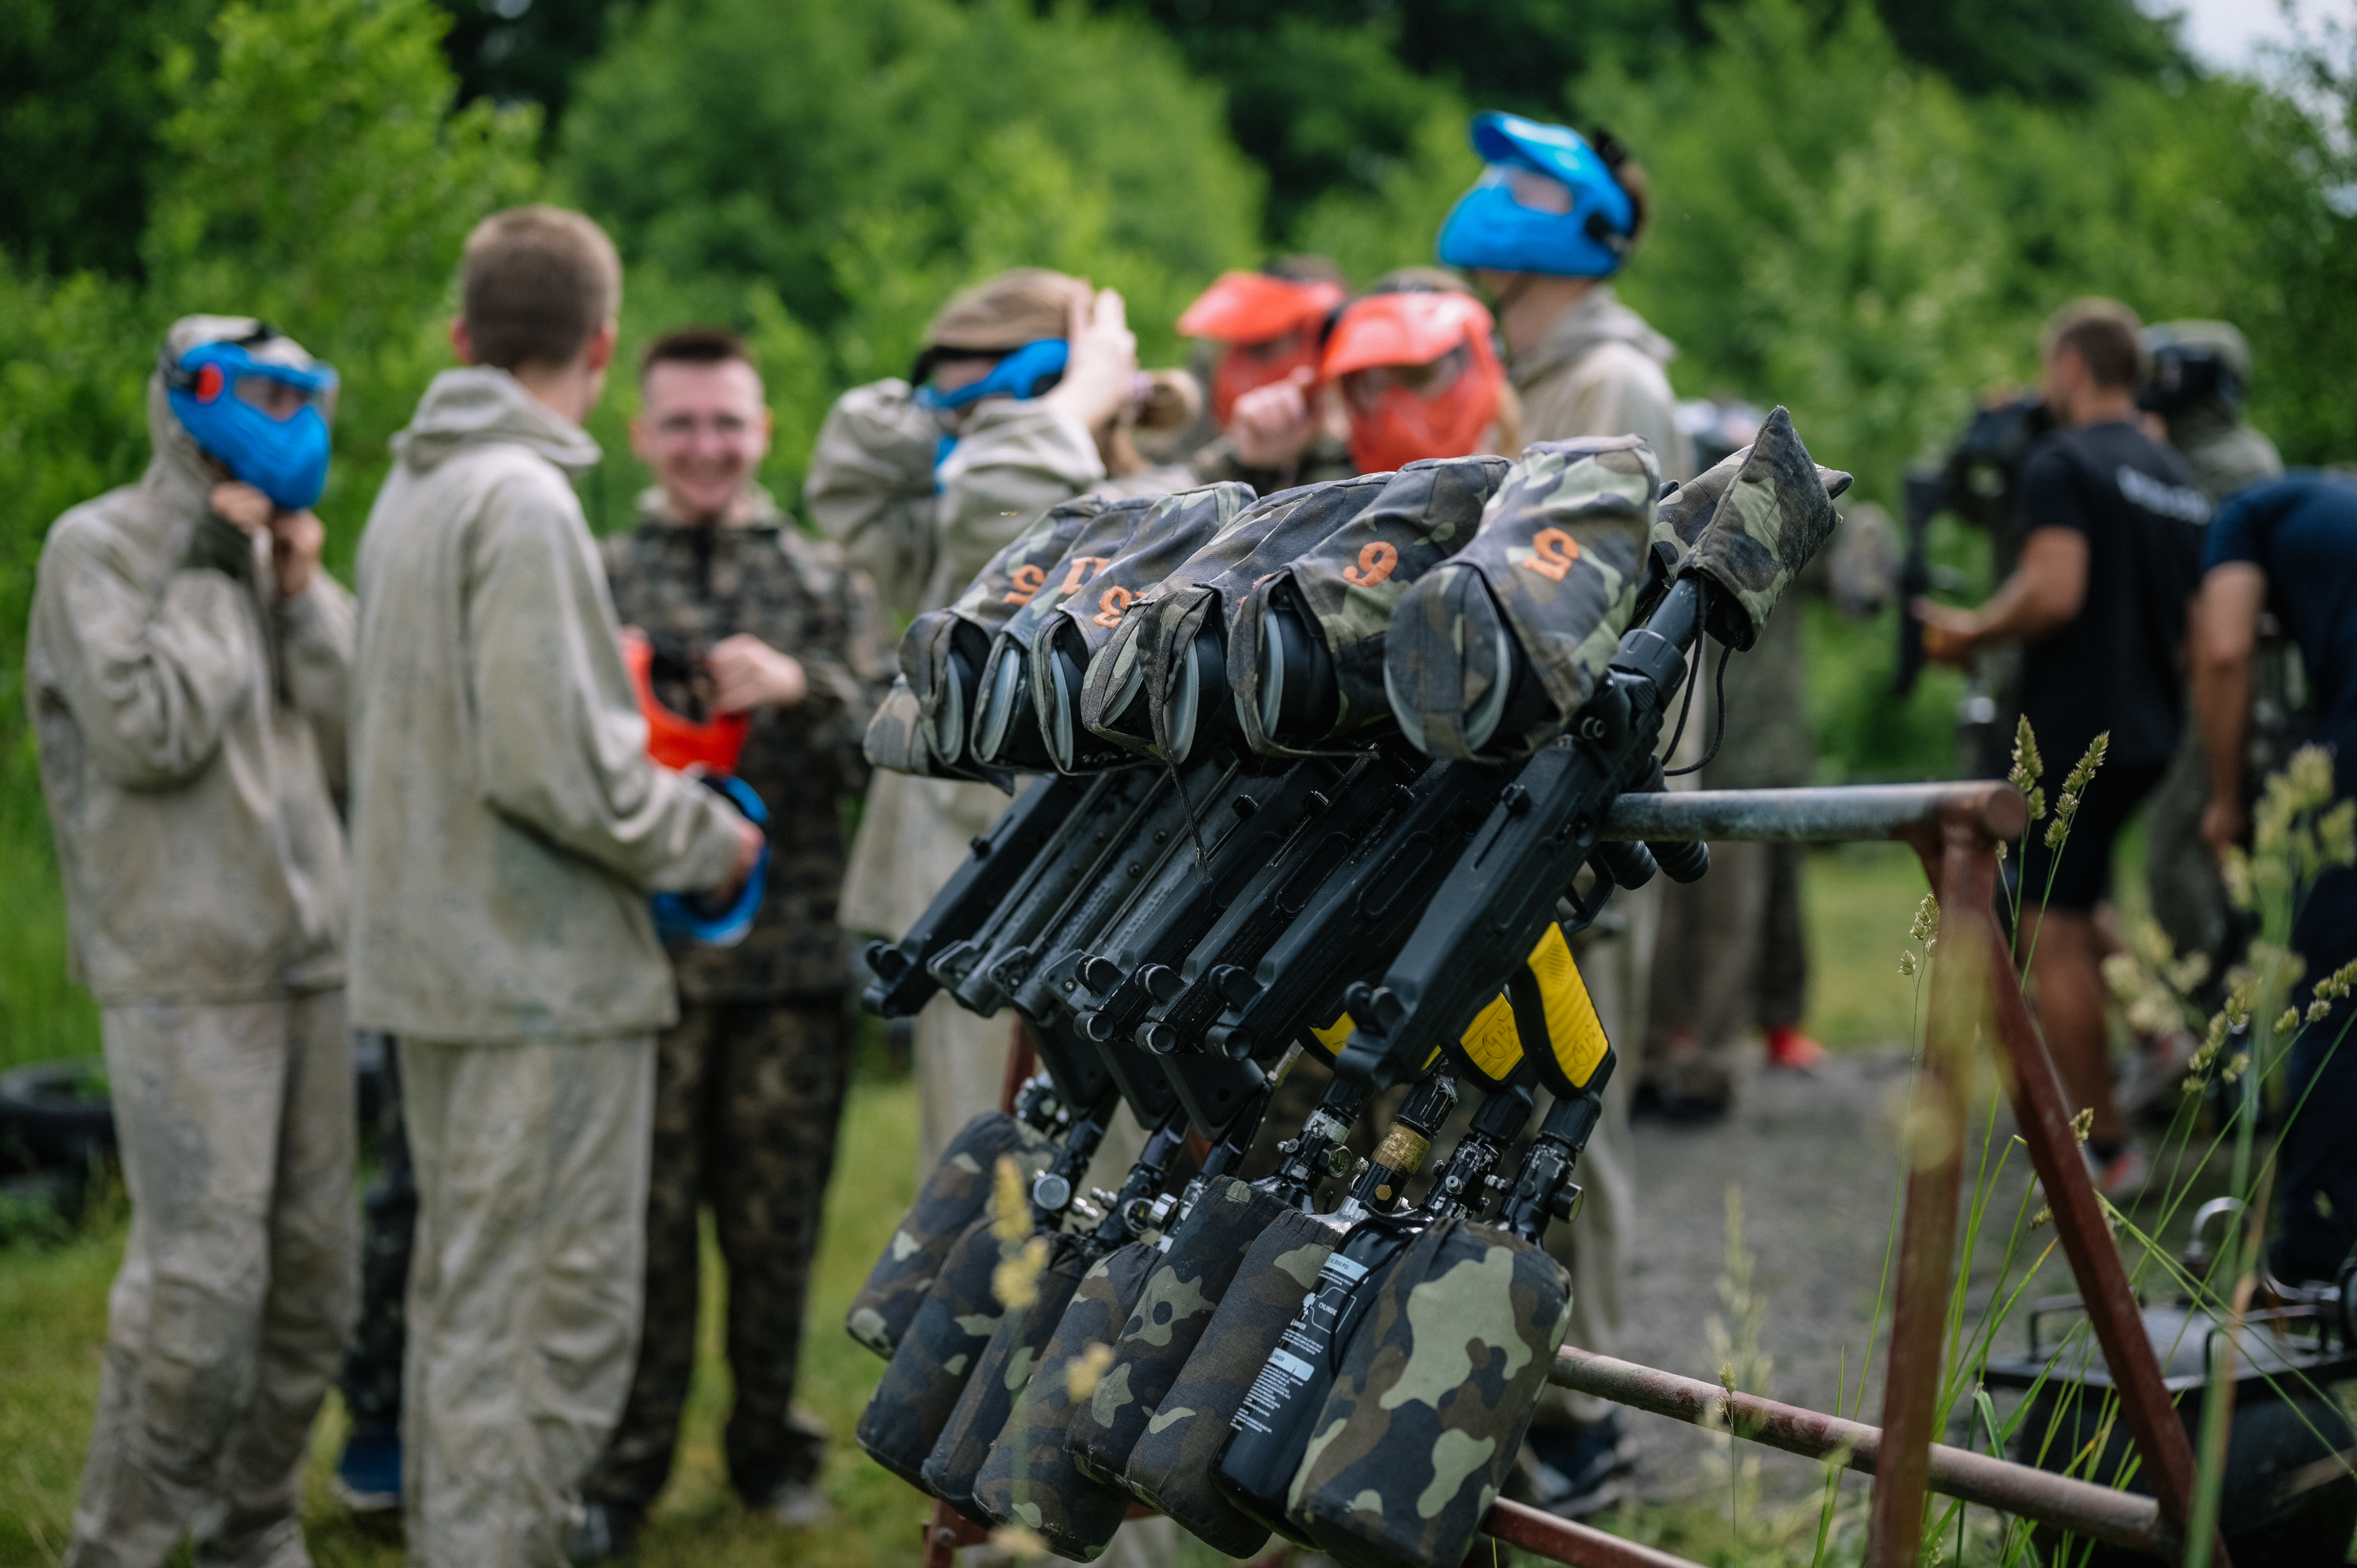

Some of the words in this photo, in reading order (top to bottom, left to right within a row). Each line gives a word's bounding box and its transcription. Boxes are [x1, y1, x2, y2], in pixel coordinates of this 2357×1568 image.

[1522, 527, 1580, 581] 5
[1221, 941, 1237, 958] Misuse
[1234, 932, 1245, 944] may
[1242, 920, 1256, 934] cause
[1176, 1003, 1192, 1020] serious
[1189, 992, 1202, 1005] injury
[1241, 925, 1261, 946] designed
[1341, 1262, 1350, 1270] PSI
[1318, 1302, 1338, 1316] CYLINDE
